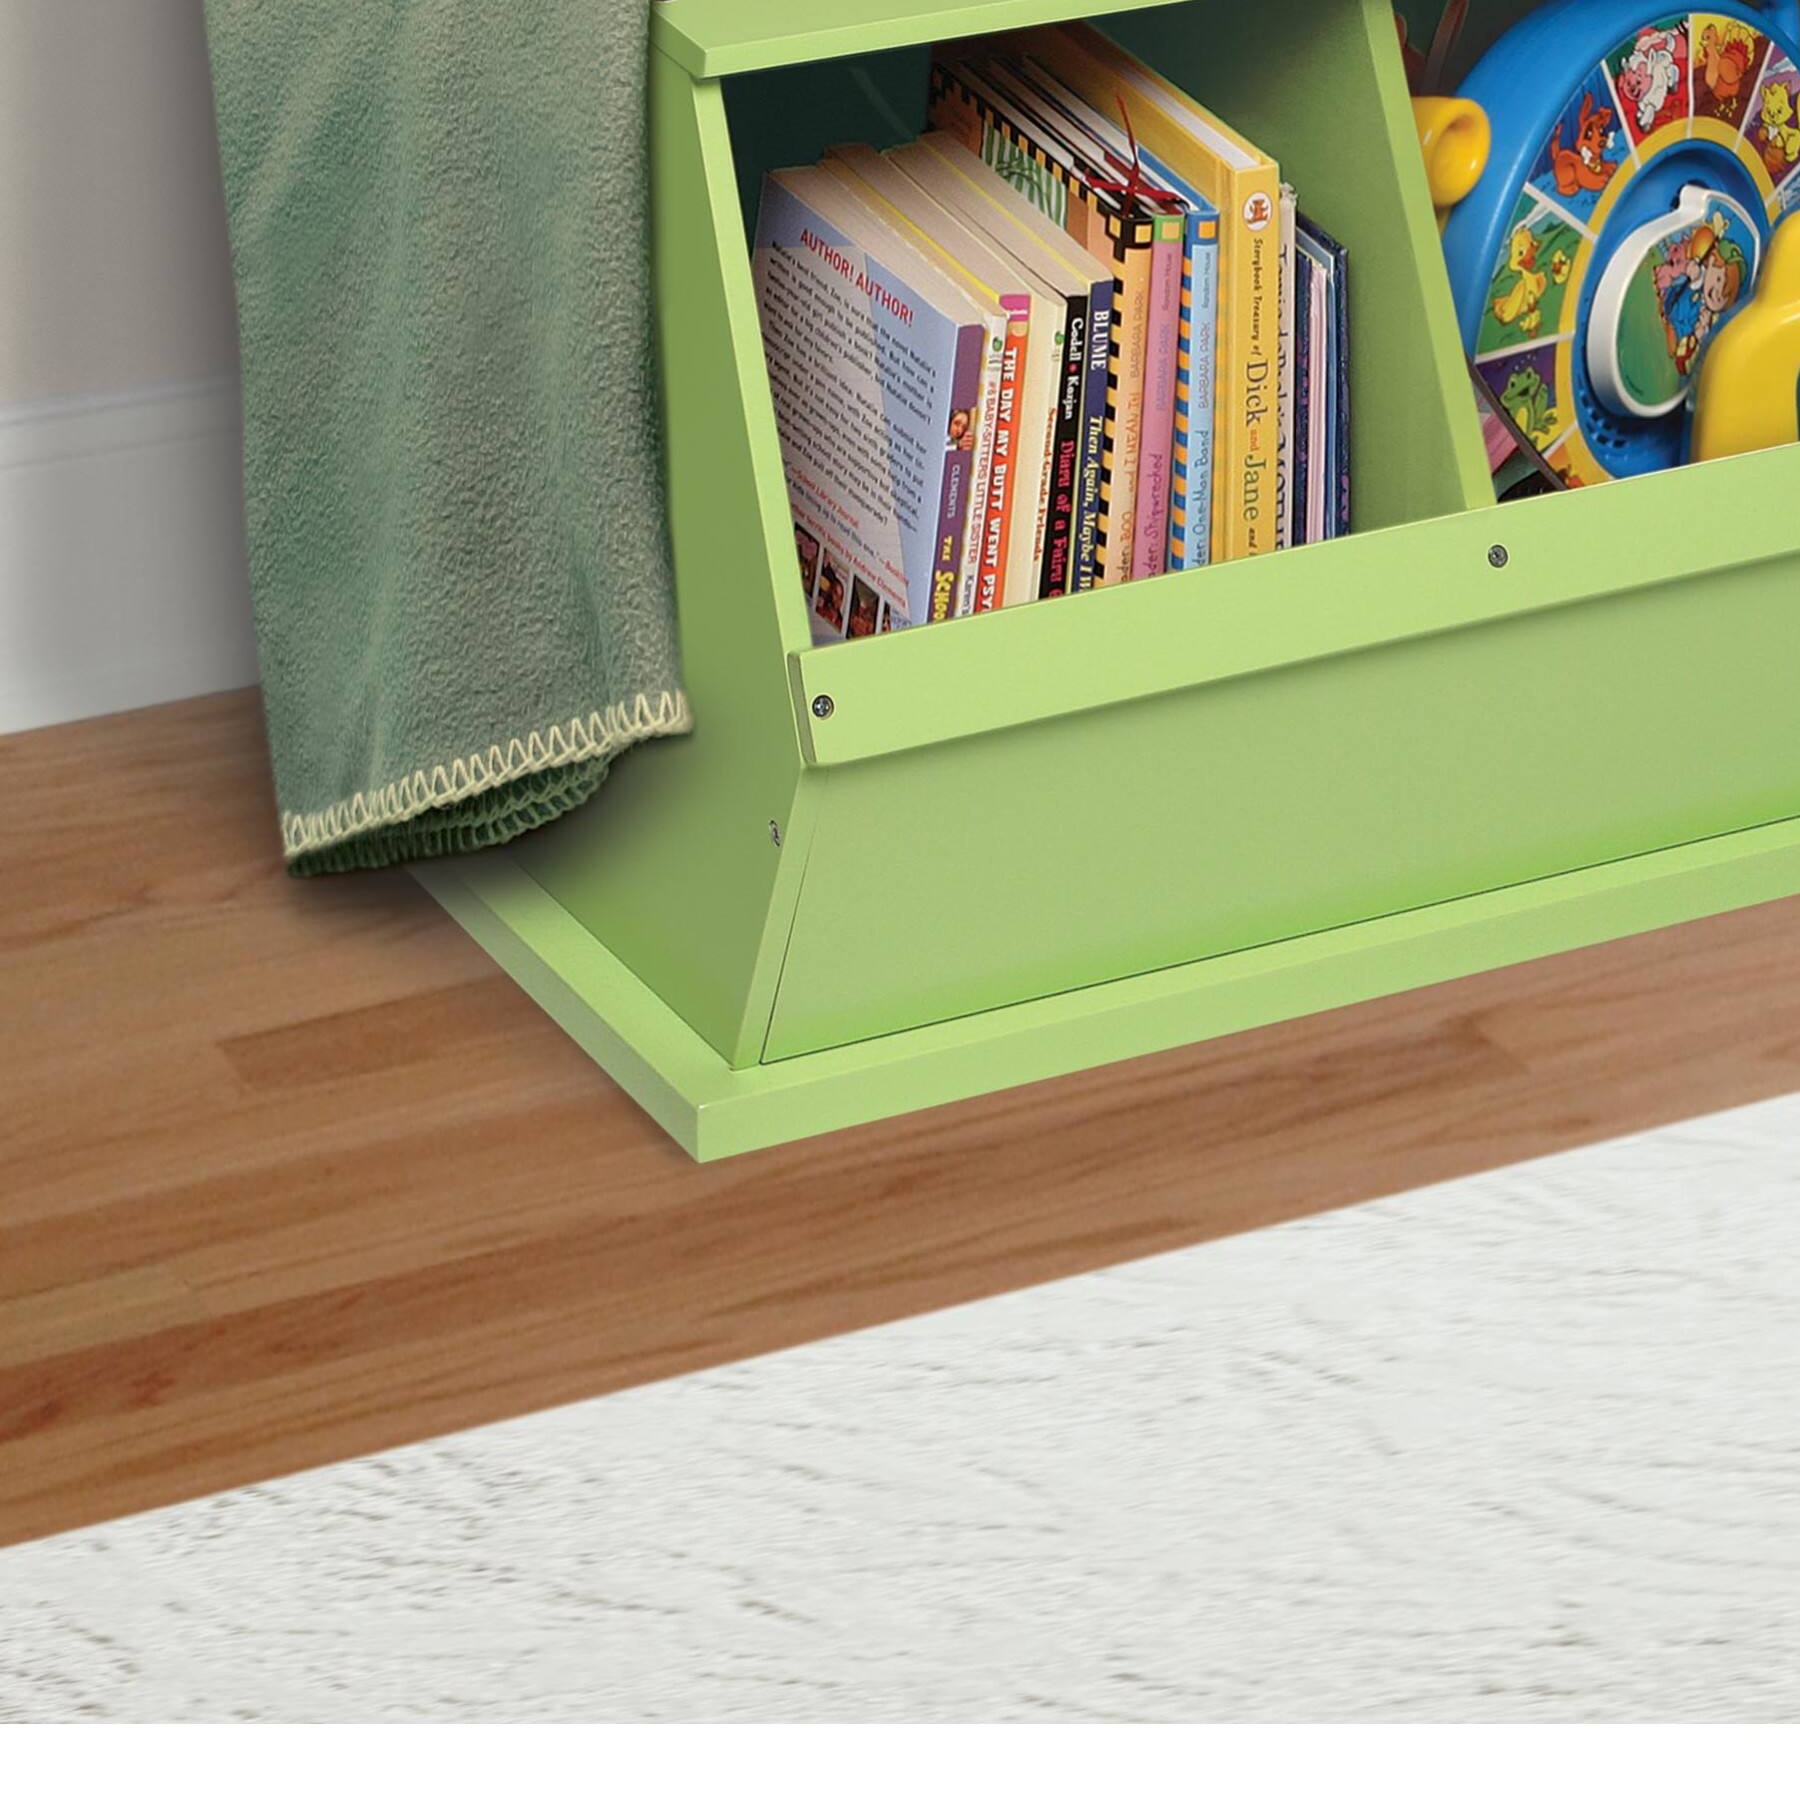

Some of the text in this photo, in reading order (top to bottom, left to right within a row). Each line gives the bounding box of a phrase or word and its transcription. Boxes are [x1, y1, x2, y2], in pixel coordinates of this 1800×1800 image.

[800, 228, 914, 328] AUTHOR! AUTHOR!
[1068, 316, 1084, 362] Codell
[1090, 309, 1110, 371] BLUME
[1129, 290, 1145, 378] BARBARA PARK
[1198, 321, 1211, 409] BARBARA PARK
[1243, 237, 1269, 548] Storybook Treasury of Dick and Jane and
[976, 397, 996, 481] BABY-SITTERS
[981, 346, 1018, 612] THE DAY MY BUTT WENT PSY
[1194, 429, 1209, 469] Band
[947, 463, 961, 519] CLEMENTS
[971, 481, 986, 521] LITTLE
[1048, 439, 1076, 599] Diary of a Fairy G
[1078, 415, 1104, 592] Then Again, Maybe I W
[967, 522, 982, 565] SISTER
[933, 569, 955, 621] SCHOO
